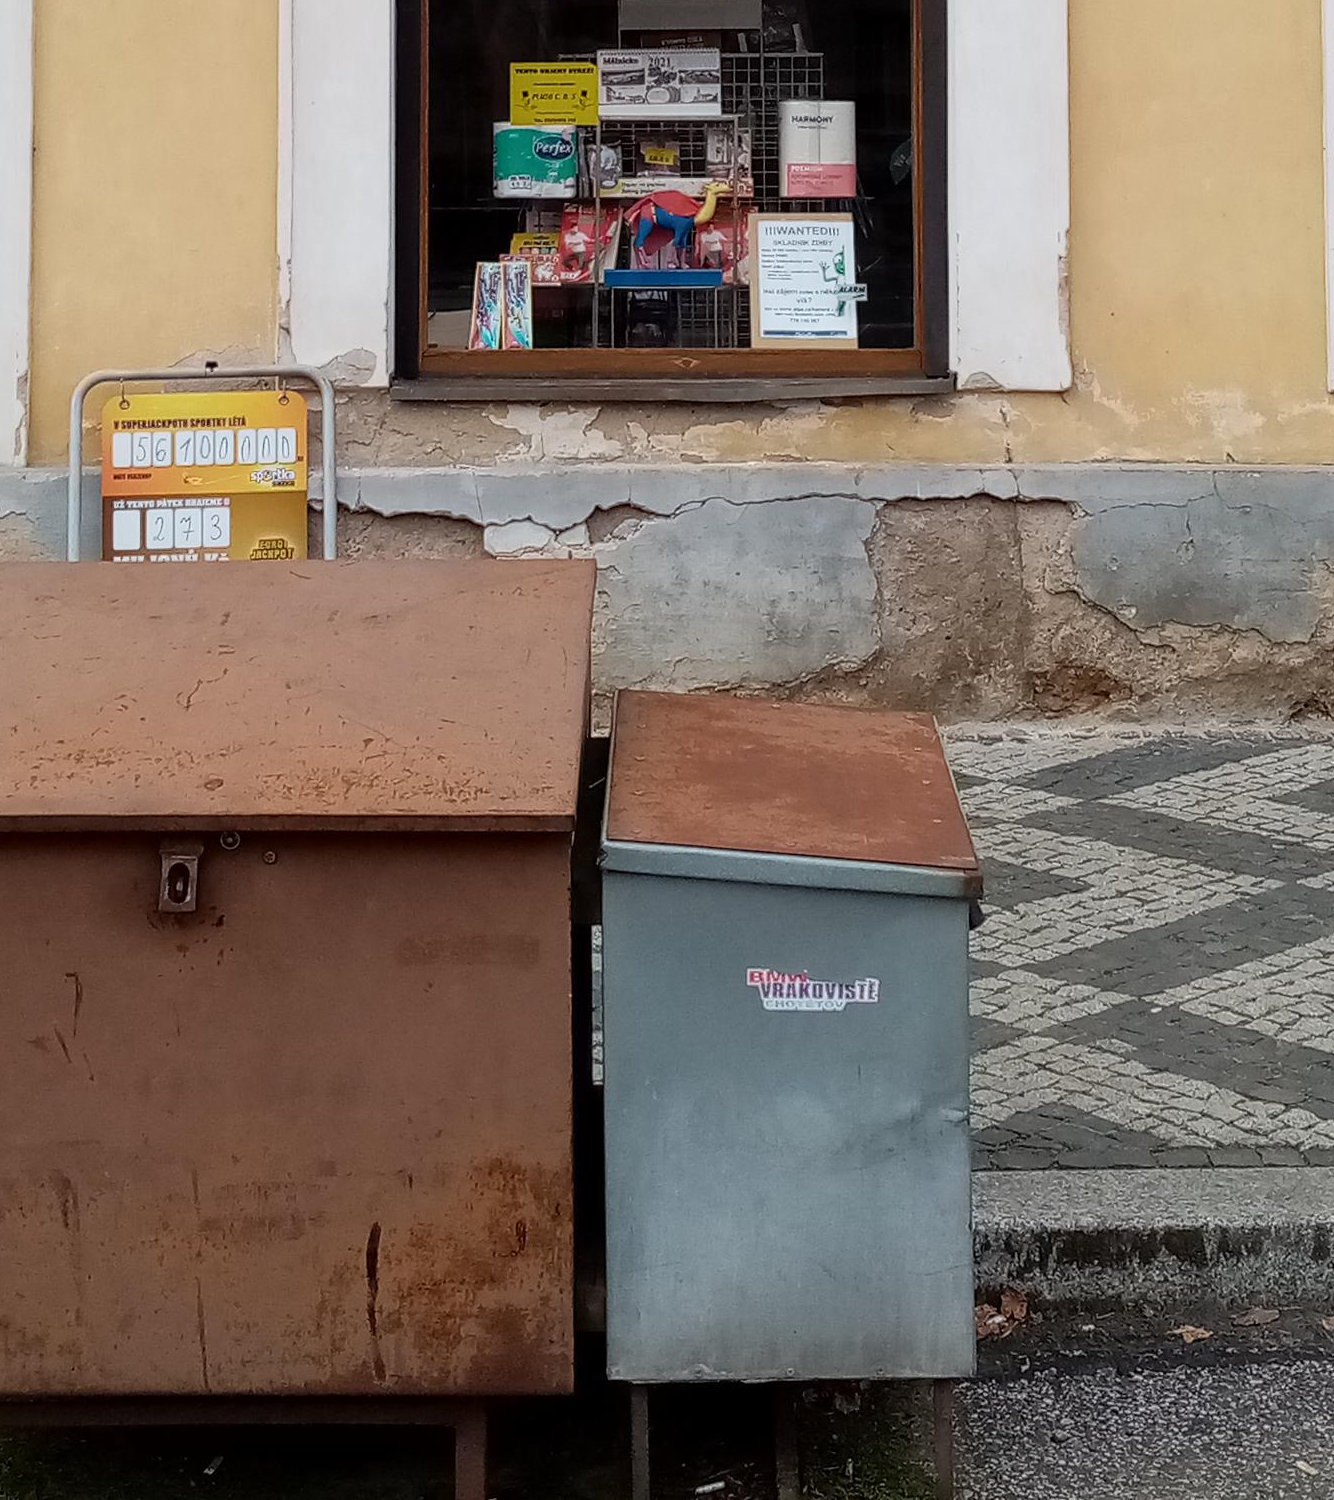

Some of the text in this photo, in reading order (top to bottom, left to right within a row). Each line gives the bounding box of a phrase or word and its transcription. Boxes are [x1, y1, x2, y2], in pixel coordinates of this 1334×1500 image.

[535, 140, 571, 156] Perfex
[113, 420, 120, 430] V
[121, 418, 189, 430] SUPERJACKPOTU
